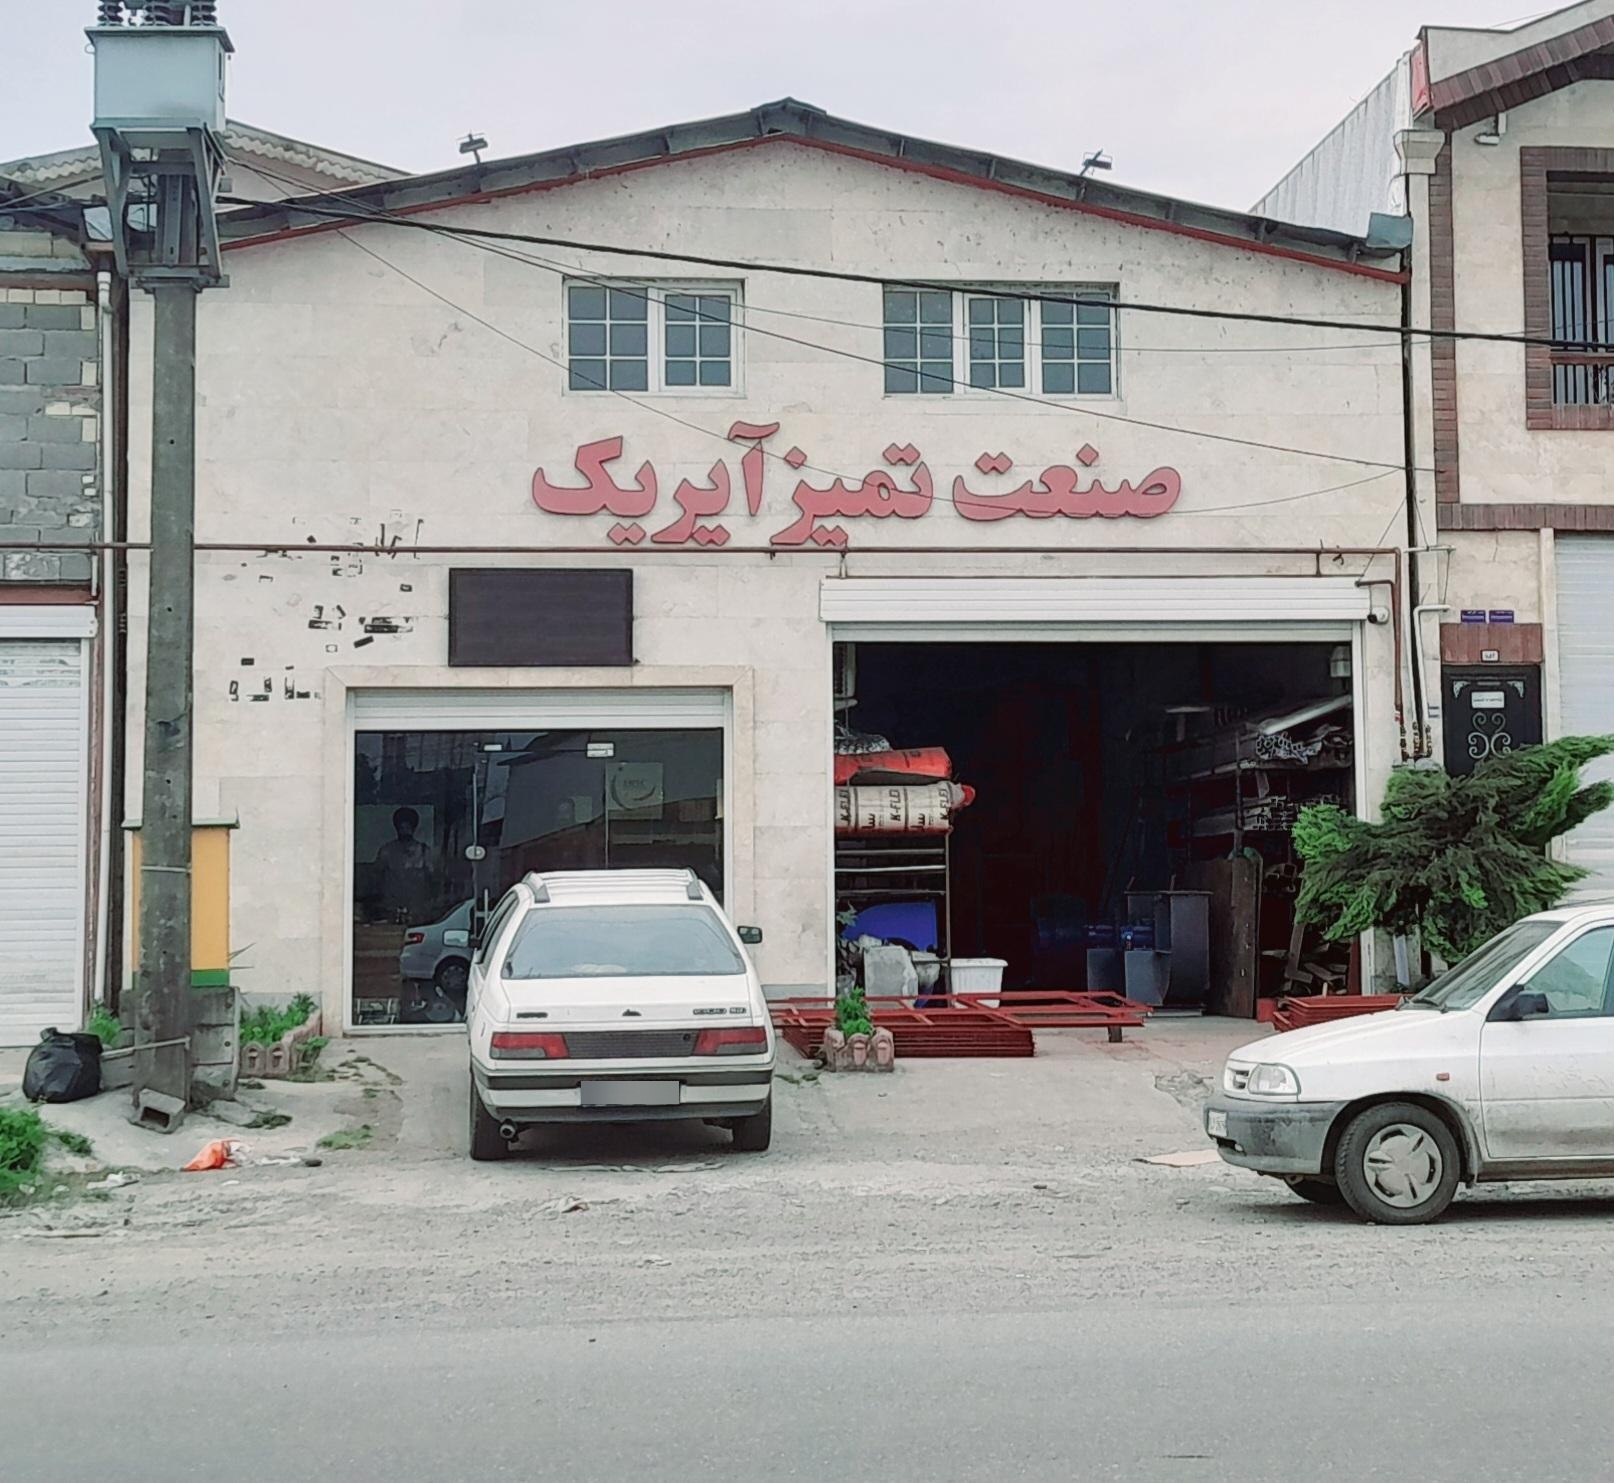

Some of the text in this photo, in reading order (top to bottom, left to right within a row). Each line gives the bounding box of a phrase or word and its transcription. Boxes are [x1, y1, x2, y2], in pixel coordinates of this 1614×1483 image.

[531, 421, 1182, 545] صنعت تمیز آیریک
